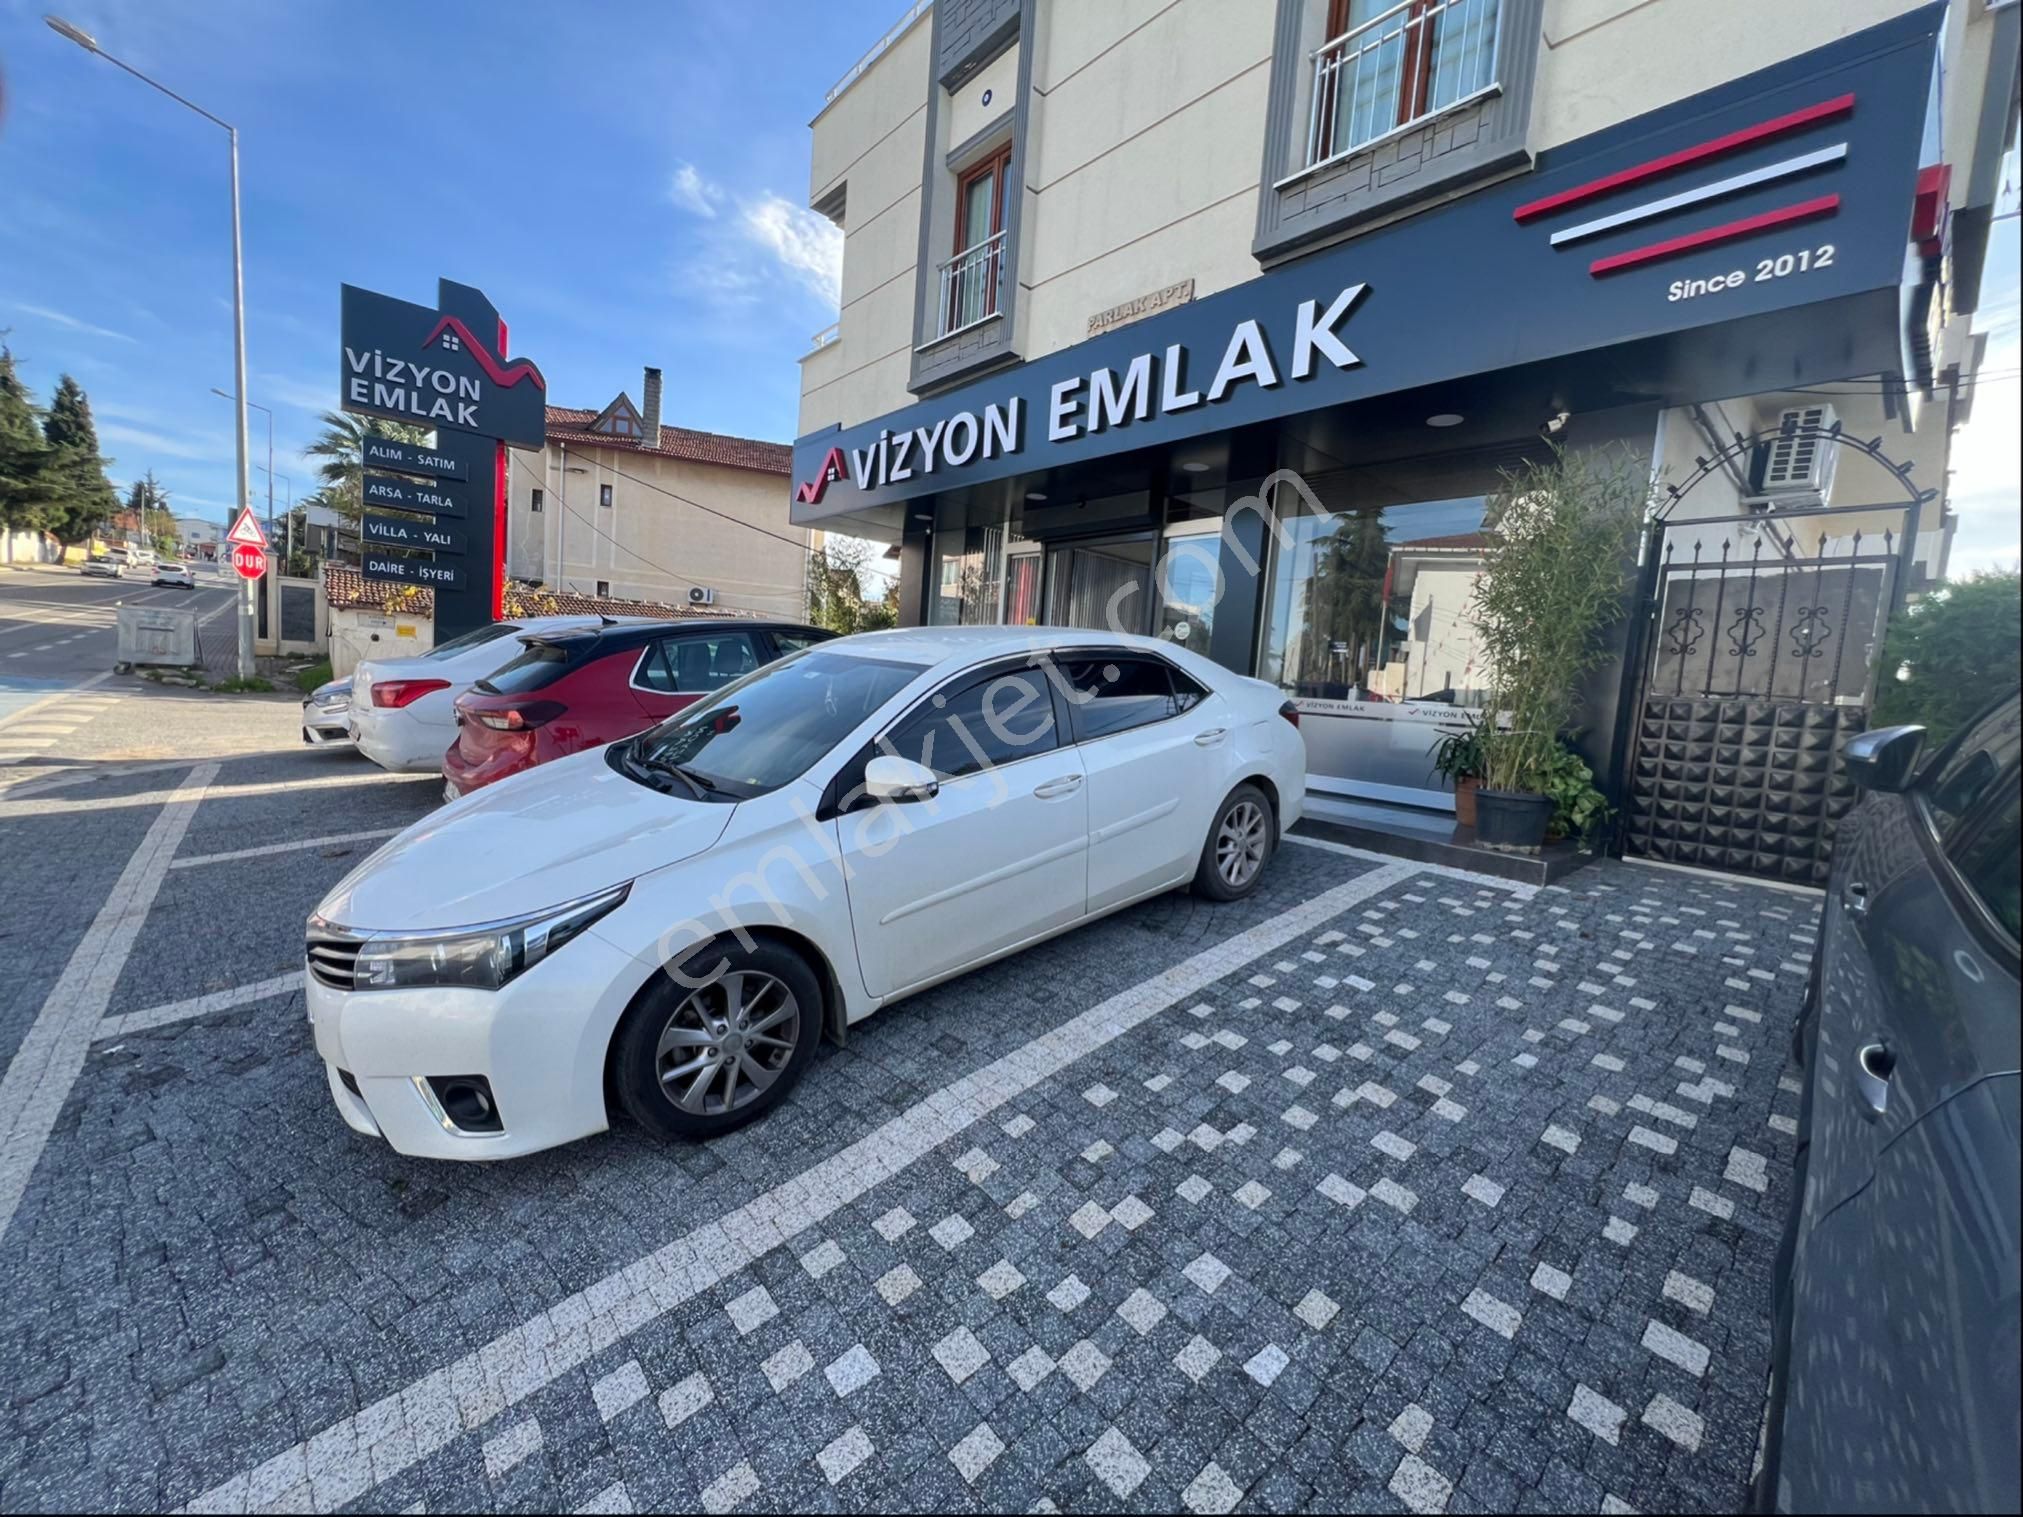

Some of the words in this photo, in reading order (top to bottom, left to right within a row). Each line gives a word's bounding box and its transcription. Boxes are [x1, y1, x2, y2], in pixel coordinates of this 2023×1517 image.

[1667, 270, 1746, 302] Since
[1754, 244, 1836, 282] 2012
[1087, 297, 1147, 333] PARLAK
[344, 346, 481, 402] VİZYON
[851, 396, 1021, 491] VİZYON
[1047, 281, 1368, 443] EMLAK
[350, 376, 479, 428] EMLAK
[369, 445, 402, 461] ALIM
[417, 454, 455, 471] SATIM
[369, 484, 403, 500] ARSA
[416, 492, 453, 508] TARLA
[369, 522, 408, 539] VİLLA
[423, 531, 451, 545] YALI
[235, 552, 264, 570] DUR
[369, 560, 405, 575] DAİRE
[419, 565, 454, 581] İŞYERİ
[1337, 703, 1366, 712] EMLAK
